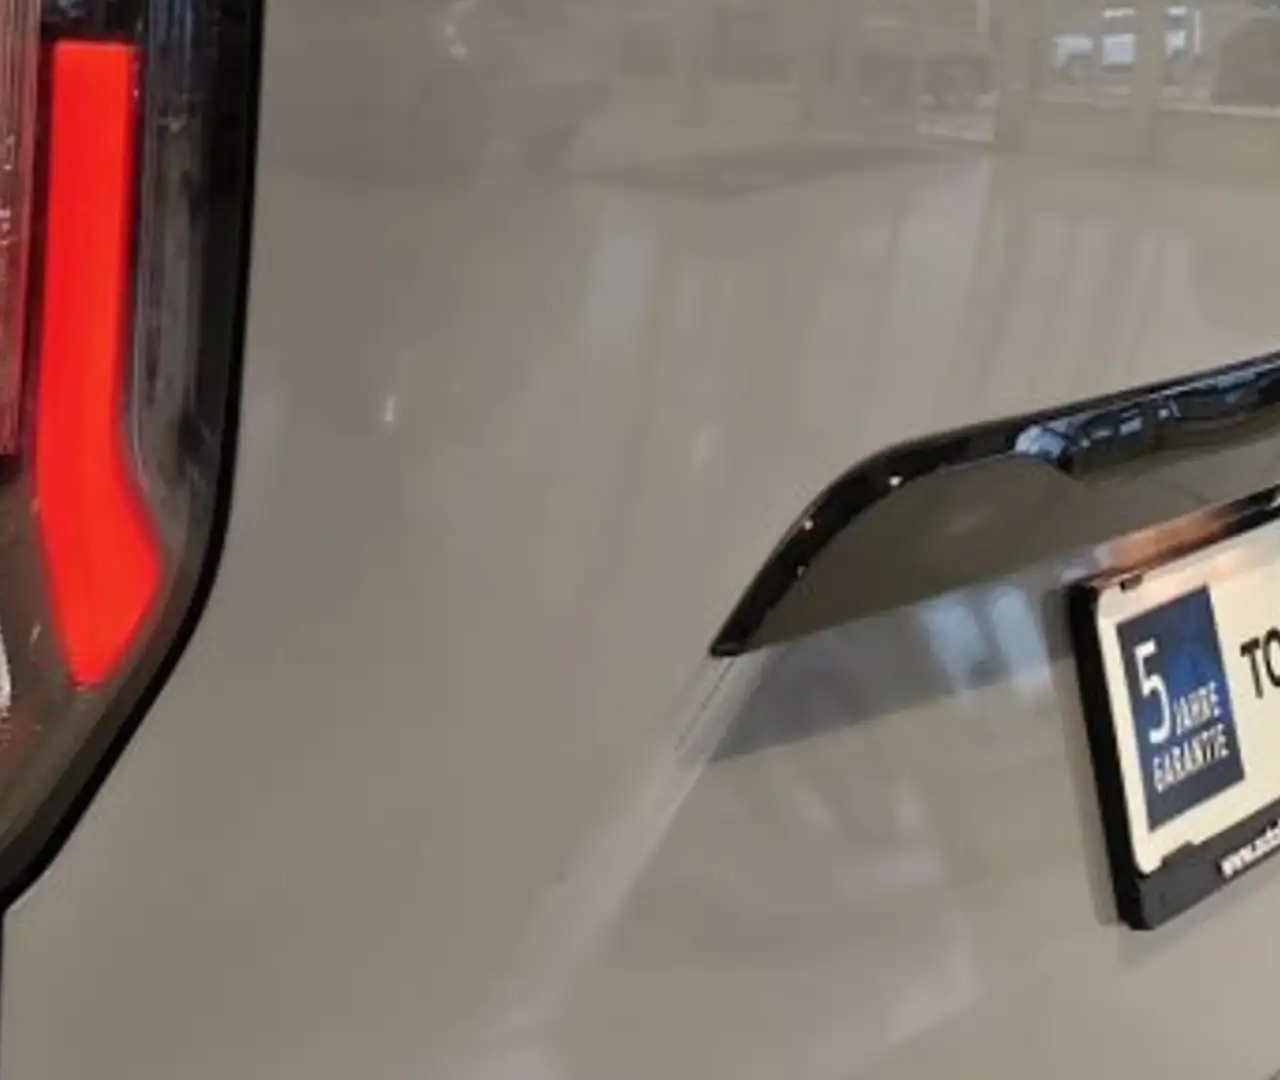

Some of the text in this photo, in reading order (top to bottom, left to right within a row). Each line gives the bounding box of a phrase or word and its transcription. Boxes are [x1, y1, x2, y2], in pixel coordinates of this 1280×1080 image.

[1134, 638, 1222, 744] 5 JAHRE
[1152, 723, 1230, 793] GARANTIE
